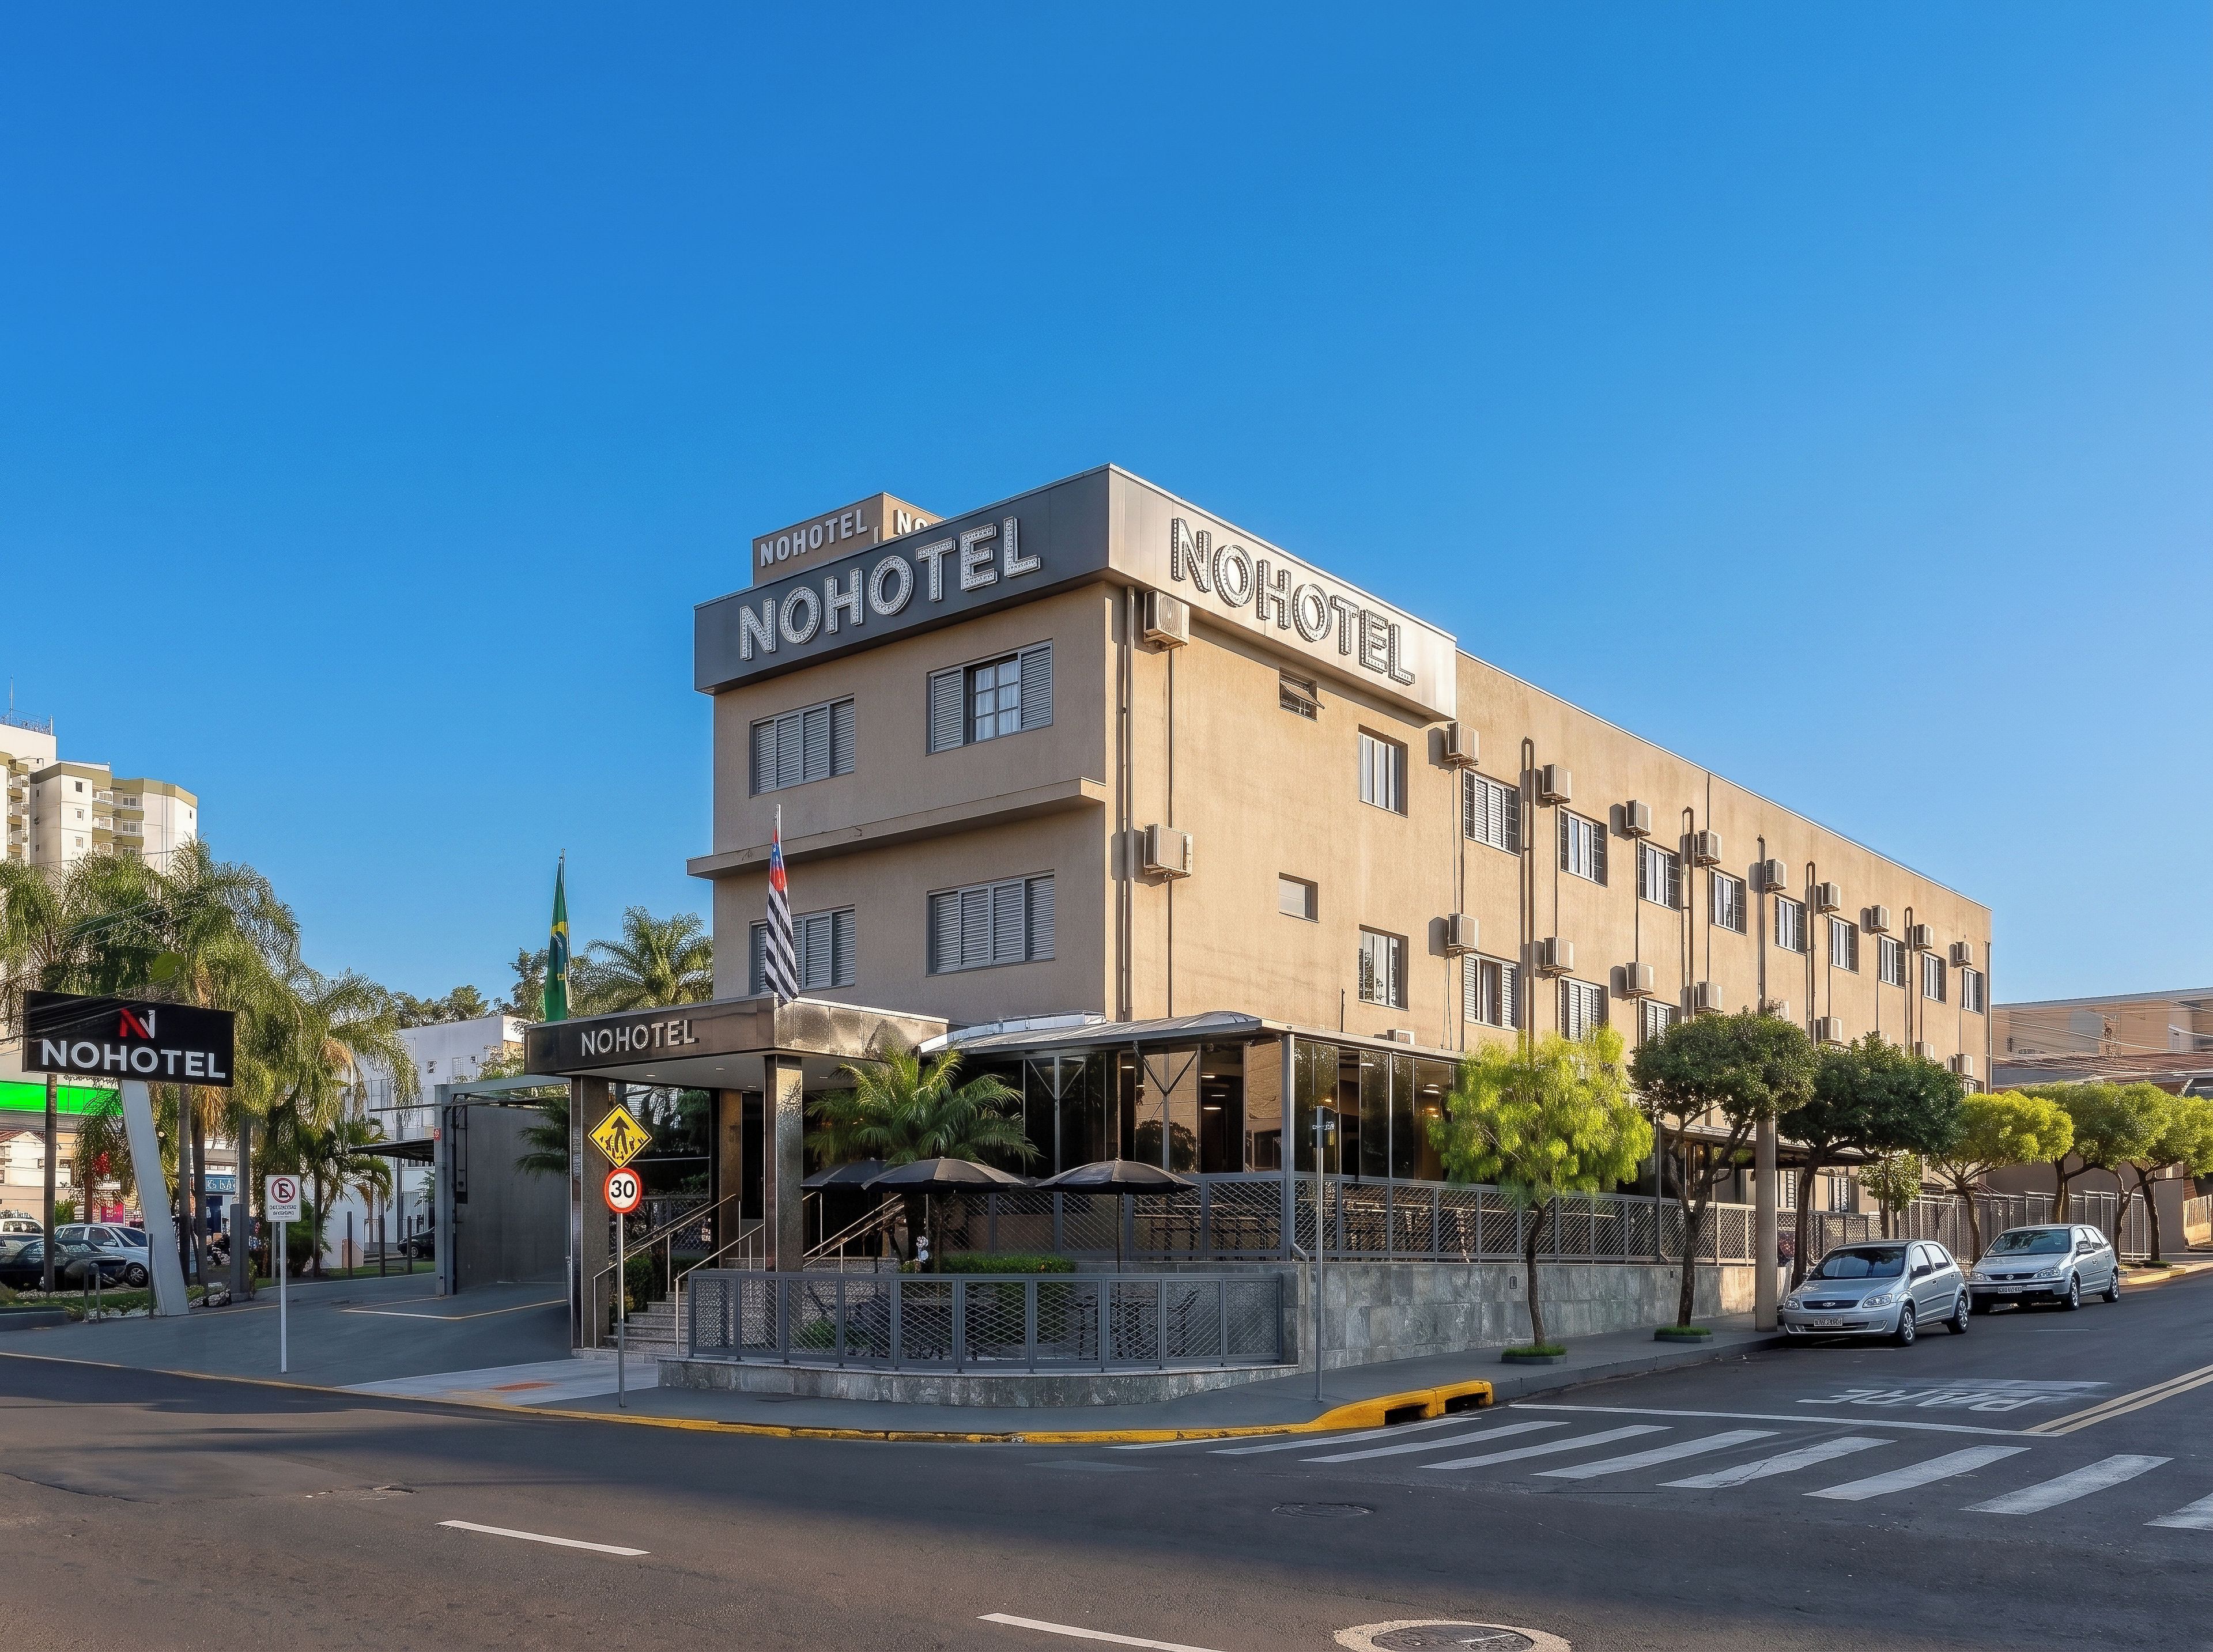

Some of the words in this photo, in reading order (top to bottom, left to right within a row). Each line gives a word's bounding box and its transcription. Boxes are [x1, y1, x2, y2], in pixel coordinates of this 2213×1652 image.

[760, 509, 868, 567] NOHOTEL
[893, 508, 934, 535] NO
[739, 516, 1041, 660] NOHOTEL
[1170, 517, 1415, 686] NOHOTEL
[581, 1019, 696, 1057] NOHOTEL
[41, 1039, 226, 1079] NOHOTEL
[610, 1180, 635, 1199] 30
